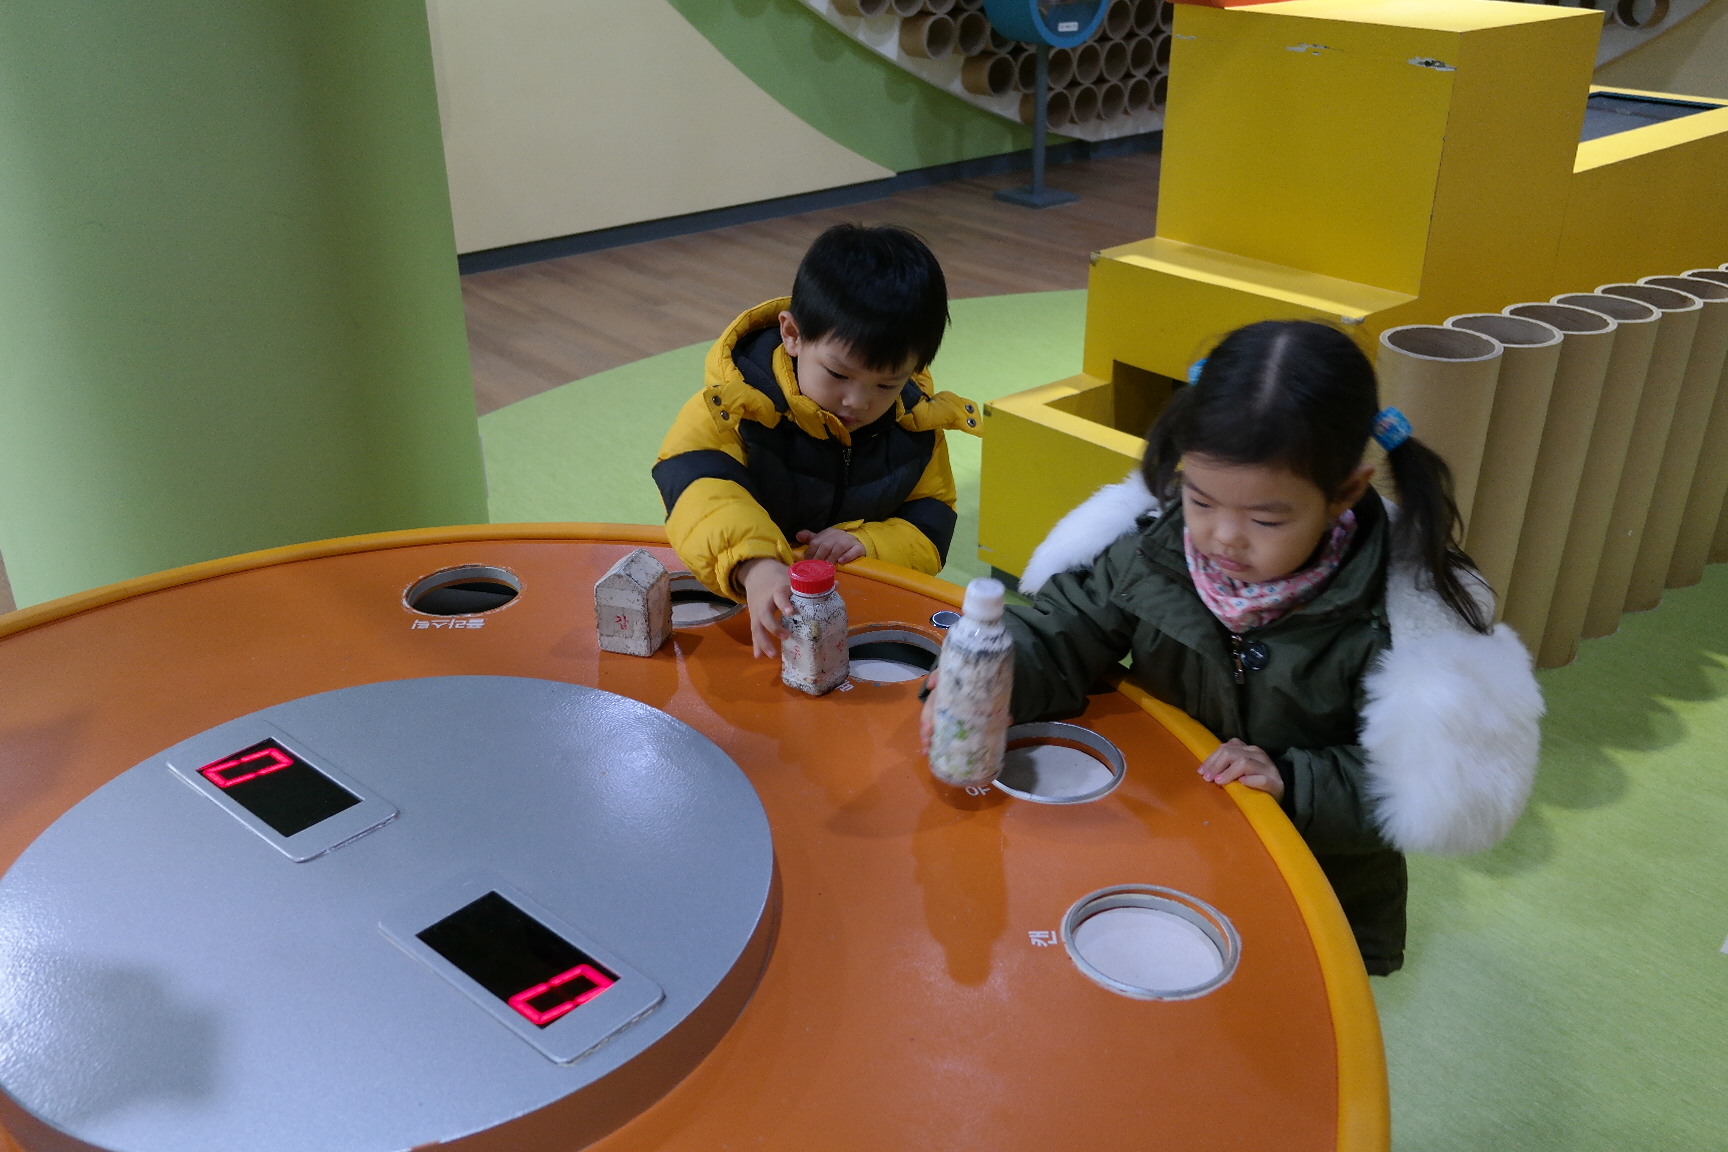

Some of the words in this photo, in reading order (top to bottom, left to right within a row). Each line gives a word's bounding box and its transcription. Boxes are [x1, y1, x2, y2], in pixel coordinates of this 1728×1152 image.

[411, 618, 486, 630] 플라스틱
[203, 746, 294, 789] 0
[1027, 930, 1058, 948] 캔
[508, 963, 616, 1026] 0
